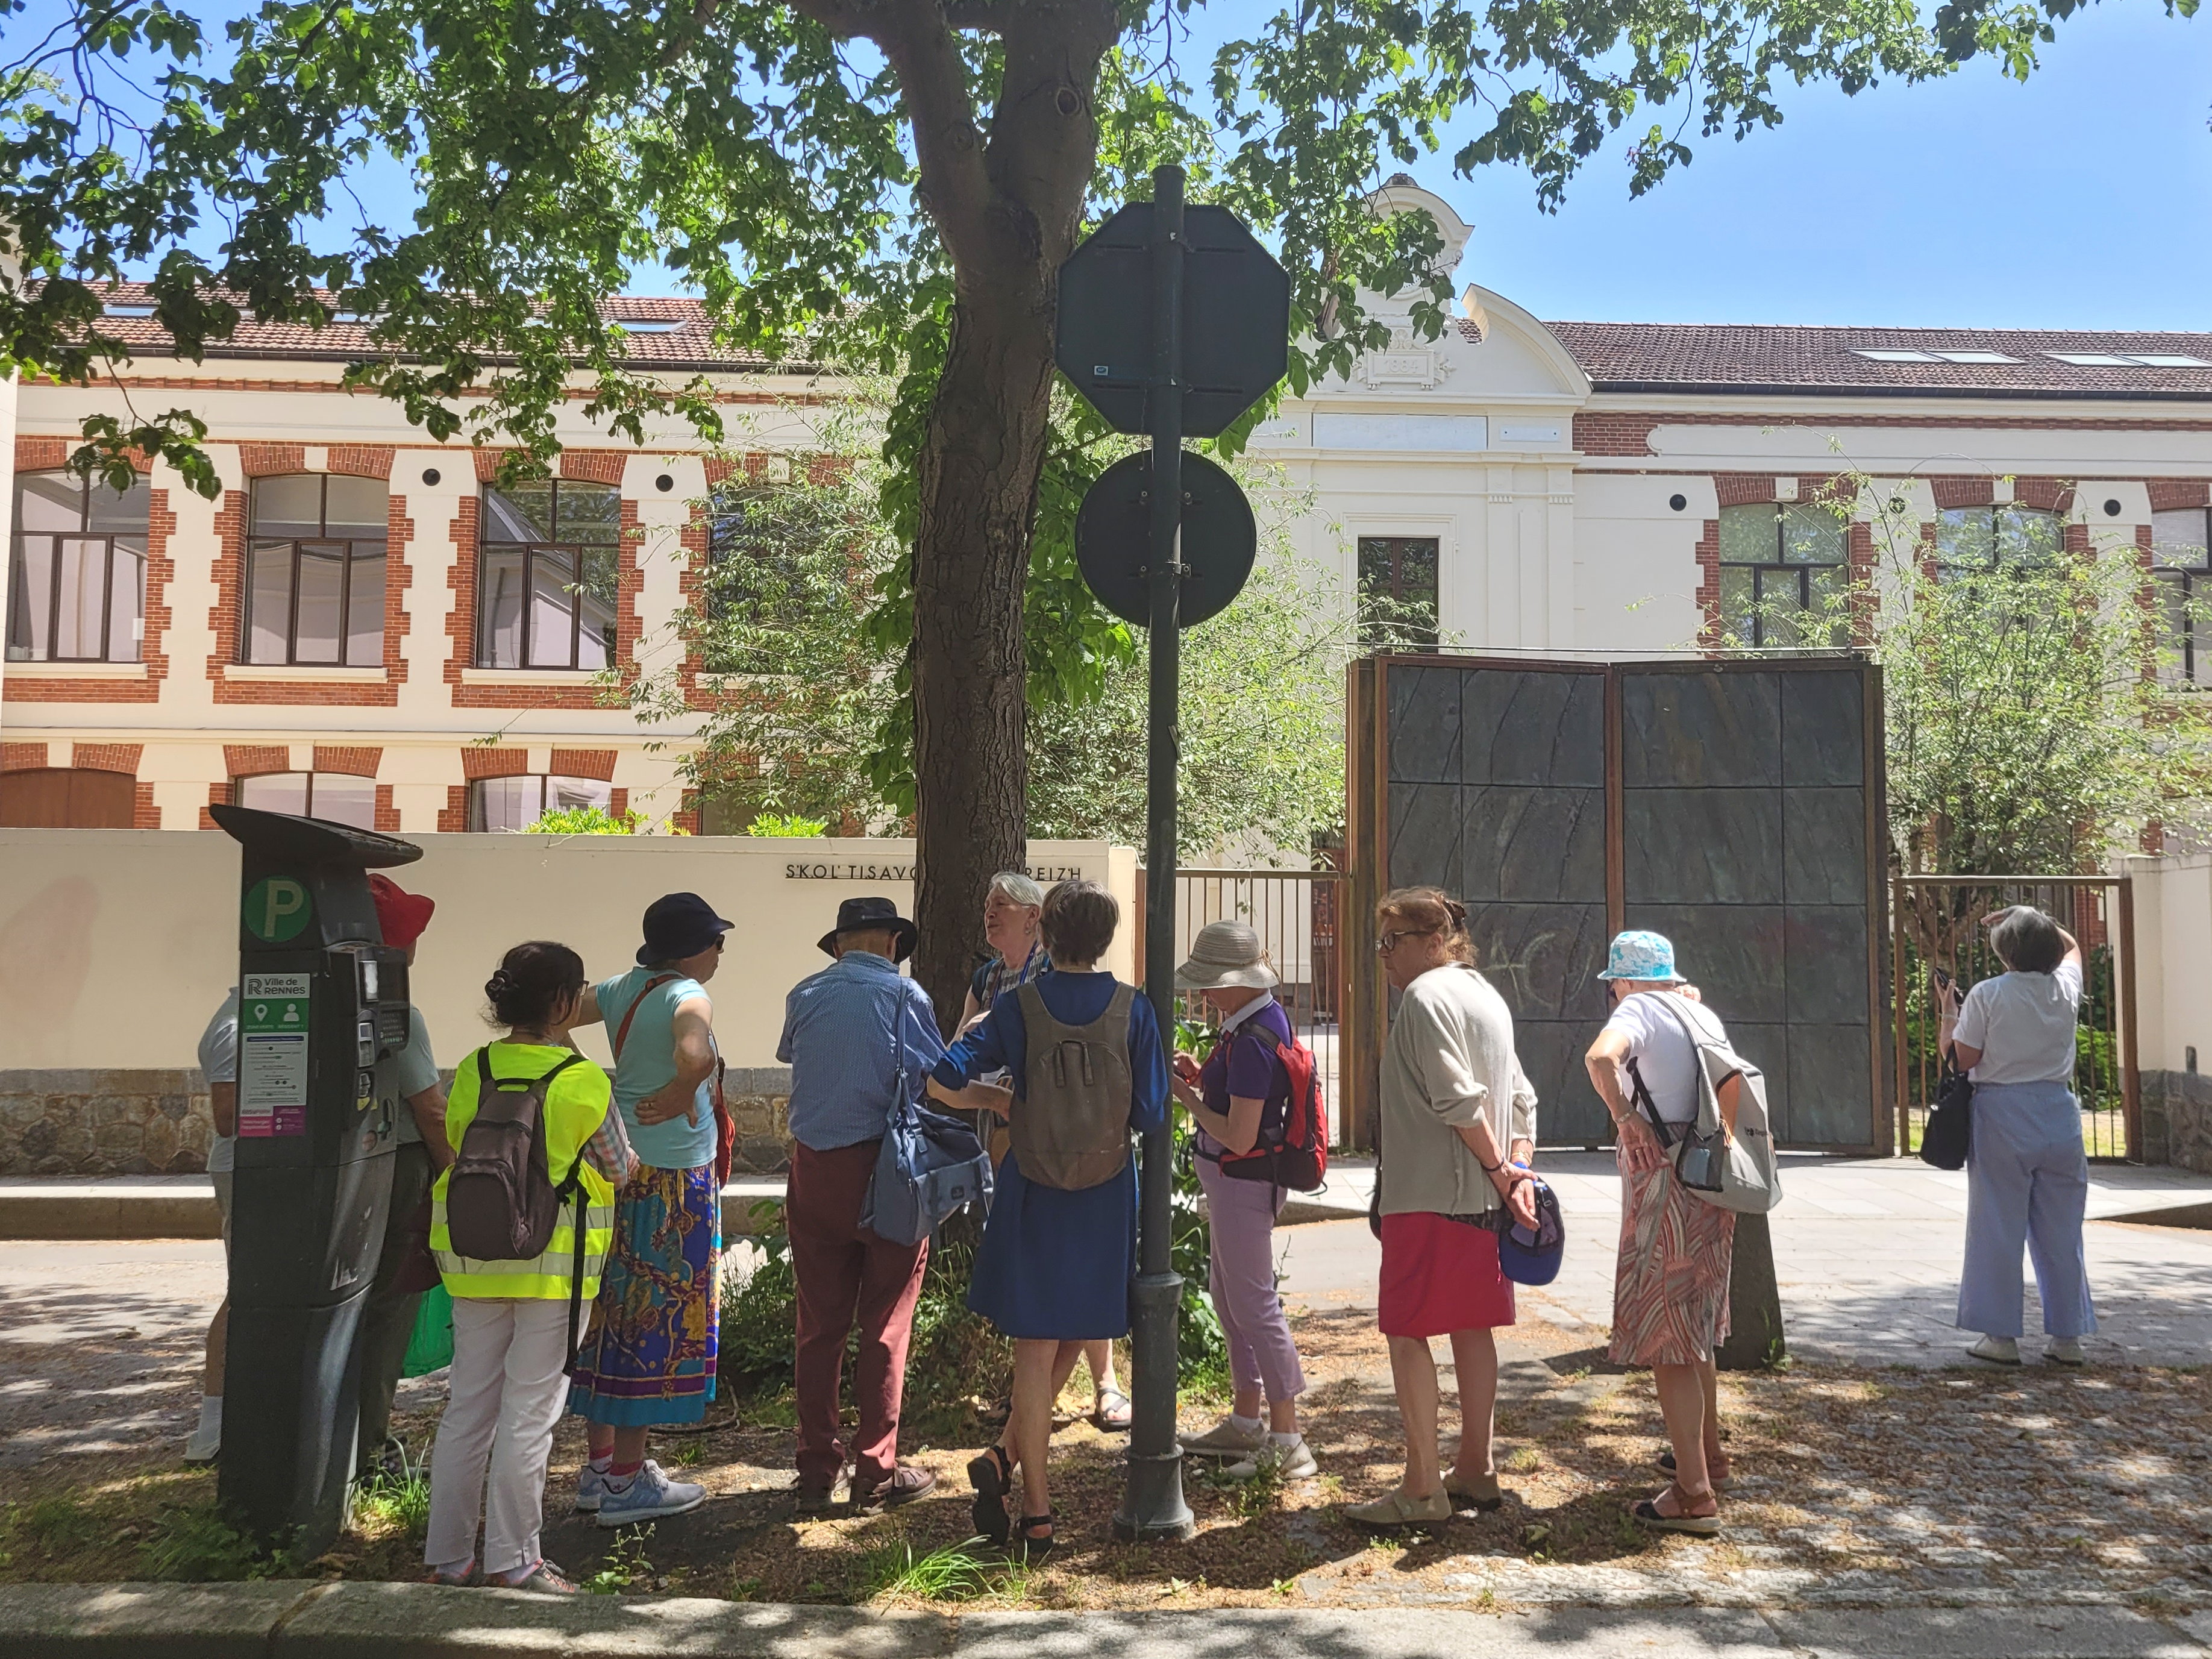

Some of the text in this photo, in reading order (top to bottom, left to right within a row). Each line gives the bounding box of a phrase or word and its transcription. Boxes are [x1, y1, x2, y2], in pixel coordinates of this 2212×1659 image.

[1383, 360, 1418, 374] 1884
[1024, 868, 1080, 881] REIZH
[264, 880, 304, 937] P
[286, 977, 298, 986] de
